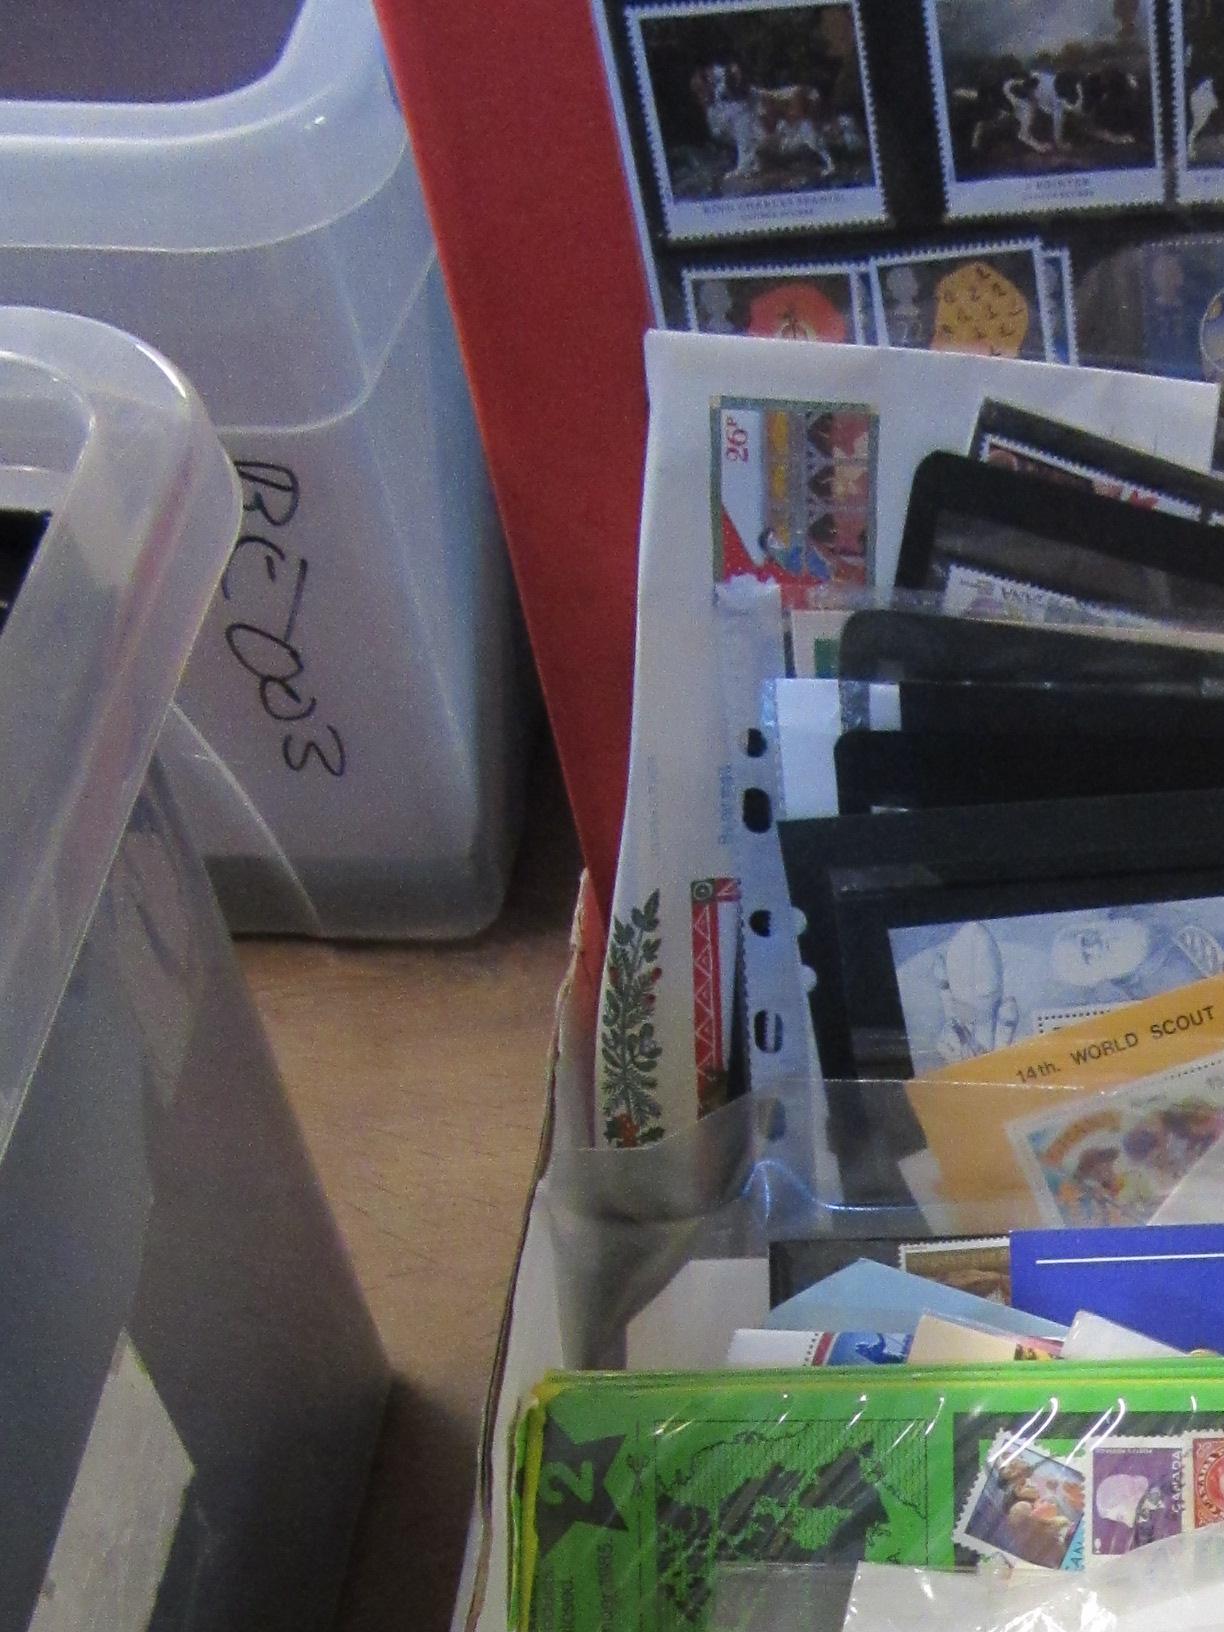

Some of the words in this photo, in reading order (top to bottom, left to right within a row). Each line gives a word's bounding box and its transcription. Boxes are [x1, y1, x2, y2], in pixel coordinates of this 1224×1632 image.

[1016, 1059, 1062, 1084] 14th.
[1069, 1032, 1139, 1066] WORLD
[1150, 1004, 1215, 1041] SCOUT
[547, 1460, 594, 1504] 2
[1170, 1450, 1183, 1514] CANADA
